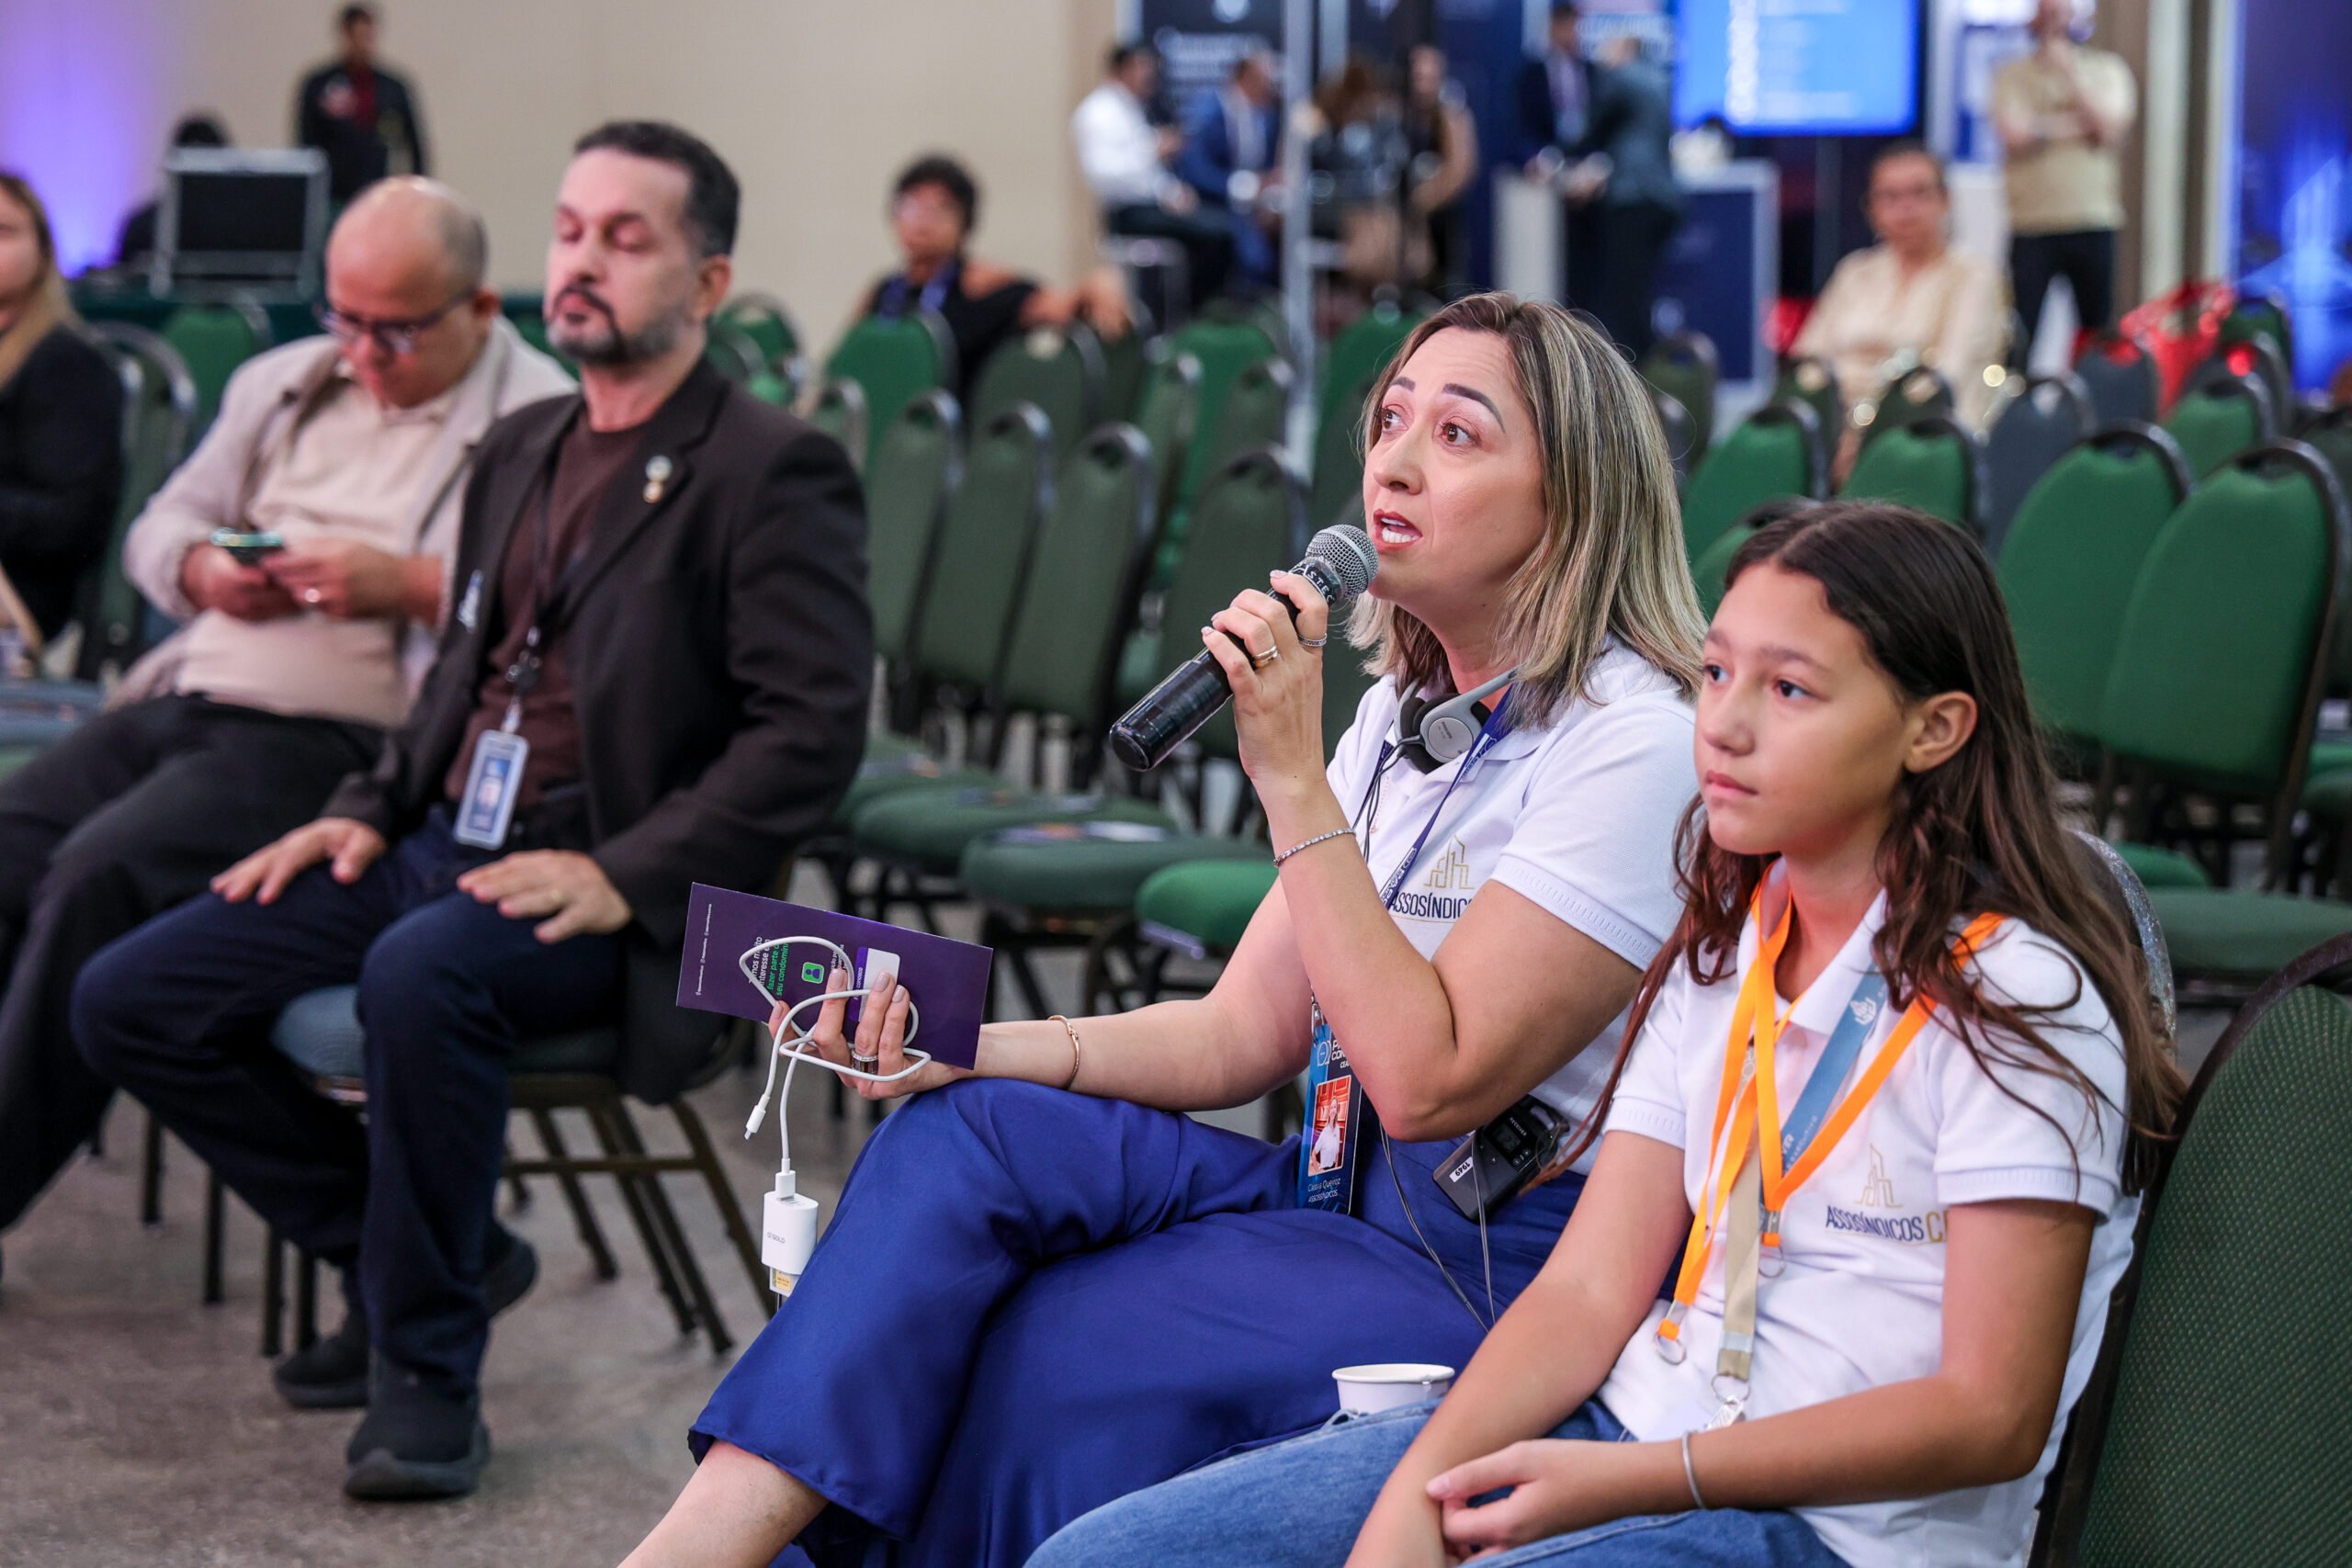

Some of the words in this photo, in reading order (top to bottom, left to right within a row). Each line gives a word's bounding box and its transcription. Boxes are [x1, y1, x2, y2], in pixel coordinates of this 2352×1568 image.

[1390, 893, 1472, 919] ASSOSÍNDIC
[769, 950, 778, 970] parte
[778, 942, 789, 982] condomíni
[766, 972, 775, 989] fazer
[1509, 1117, 1527, 1136] RECEIVER
[1454, 1162, 1470, 1176] 1949
[1826, 1205, 1924, 1241] ASSOSÍNDICOS
